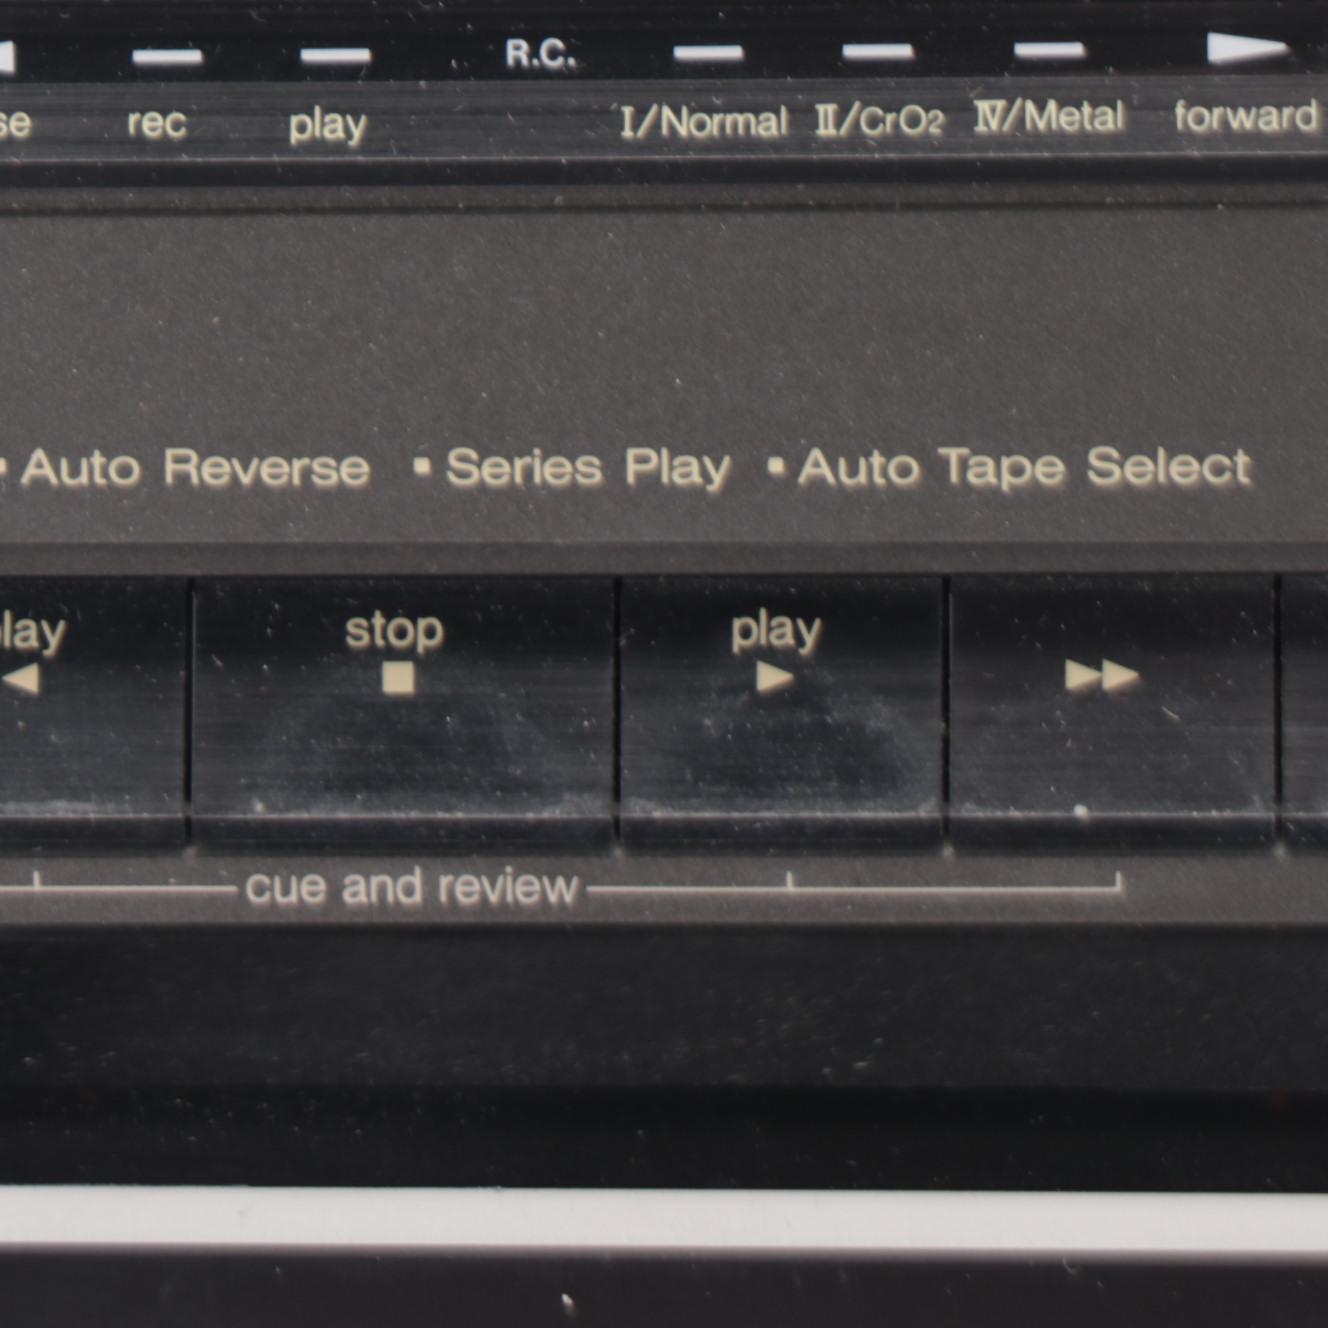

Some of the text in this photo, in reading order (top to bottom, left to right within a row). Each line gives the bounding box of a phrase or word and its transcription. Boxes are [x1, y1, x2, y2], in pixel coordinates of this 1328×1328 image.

[506, 37, 576, 69] R.C.
[128, 111, 187, 139] rec
[289, 105, 367, 147] play
[1175, 99, 1319, 133] forward
[20, 446, 1251, 493] Auto Reverse Series Play Auto Tape Select
[345, 610, 444, 655] stop
[732, 607, 821, 657] play
[246, 865, 579, 906] cue and review
